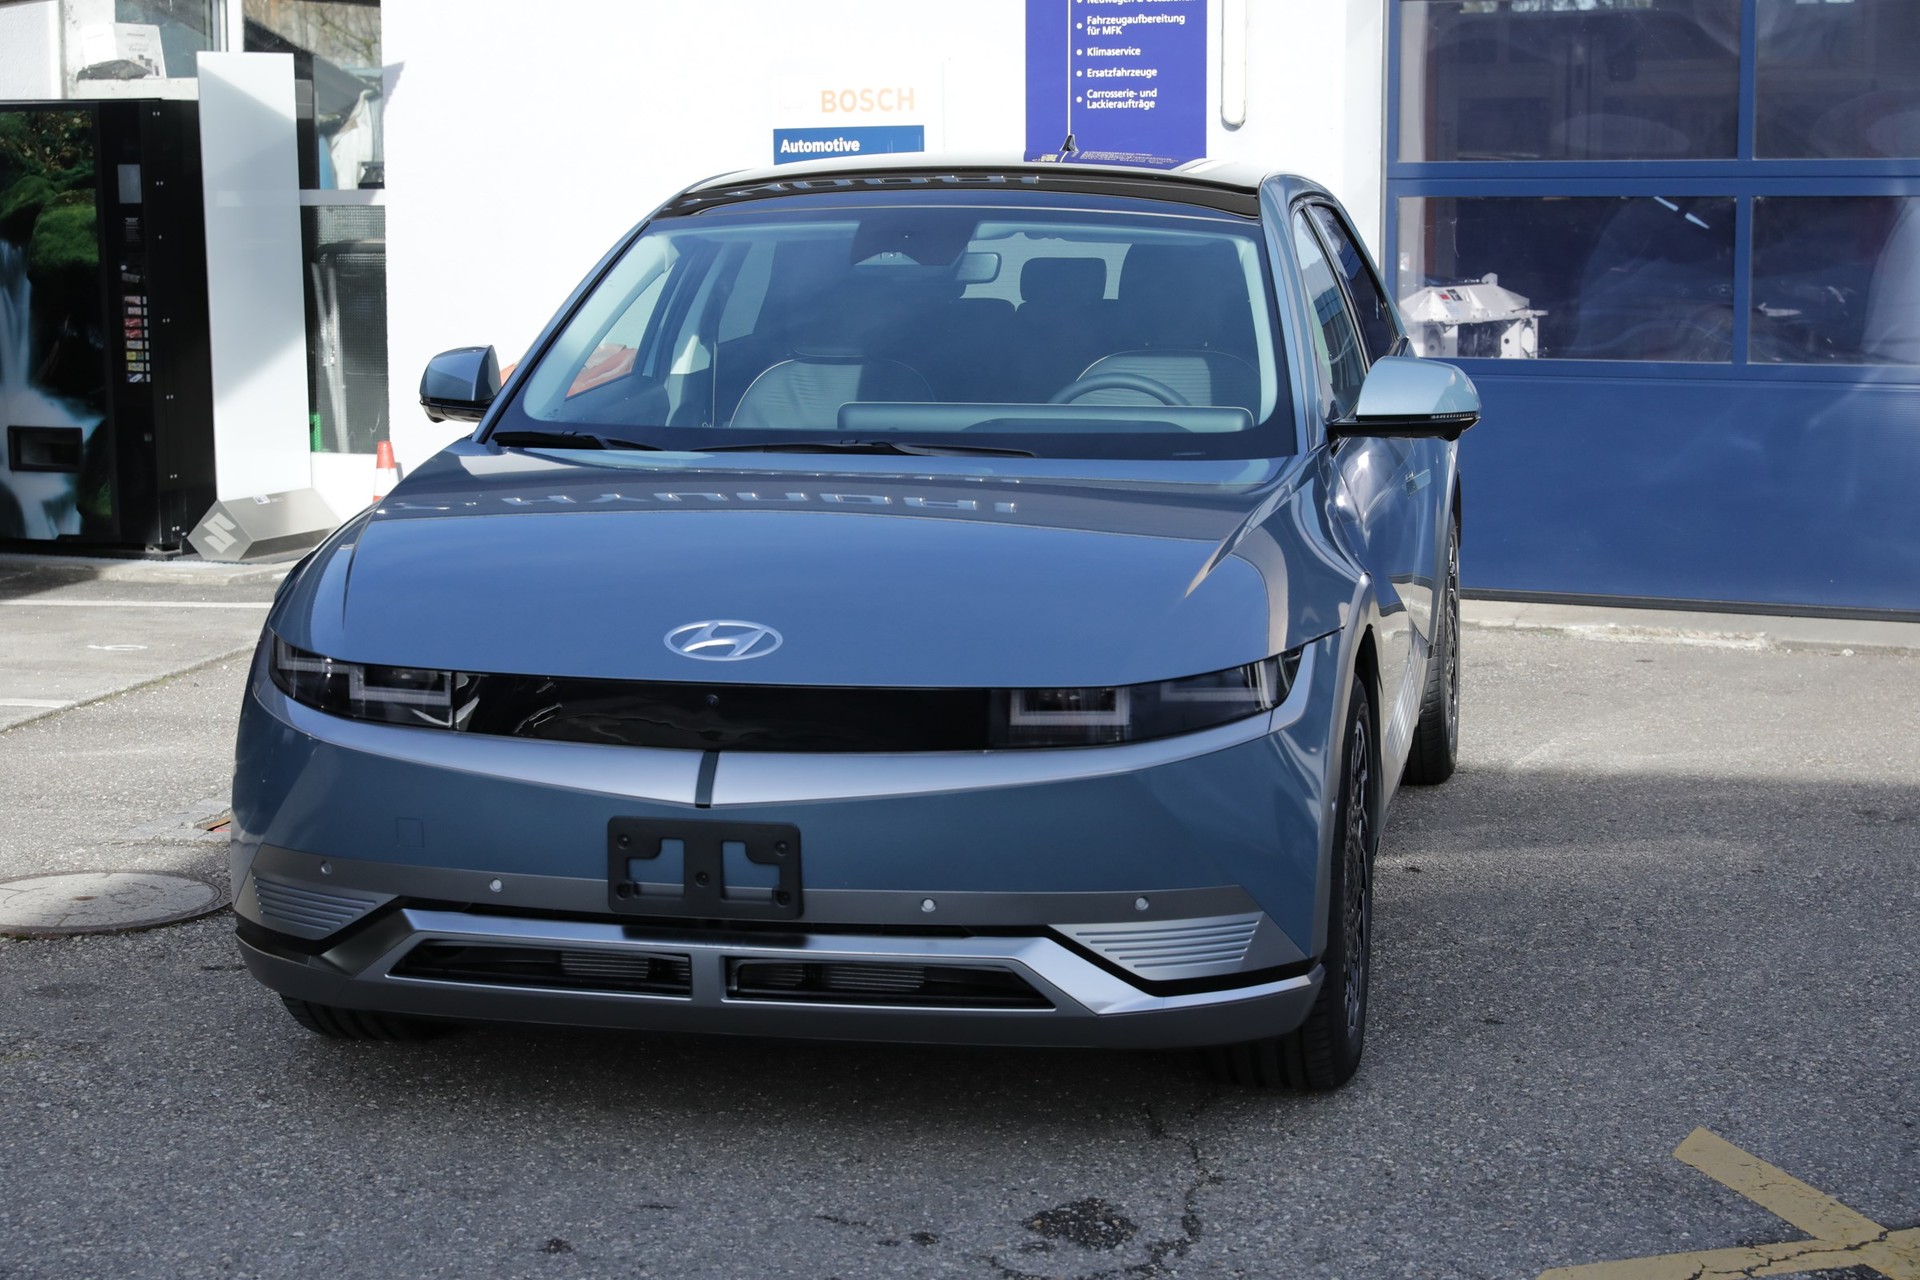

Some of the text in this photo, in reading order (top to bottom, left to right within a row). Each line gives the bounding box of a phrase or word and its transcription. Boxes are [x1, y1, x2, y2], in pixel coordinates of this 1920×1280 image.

[1087, 14, 1186, 26] Fahrzeugaufbereitung
[1087, 26, 1122, 35] für MFK
[1087, 47, 1141, 56] Klimaservice
[1087, 67, 1157, 78] Ersatzfahrzeuge
[1087, 88, 1157, 98] Carrosserie- und
[821, 87, 915, 113] BOSCH
[1087, 99, 1155, 110] Lackieraufträge
[780, 137, 860, 153] Automotive
